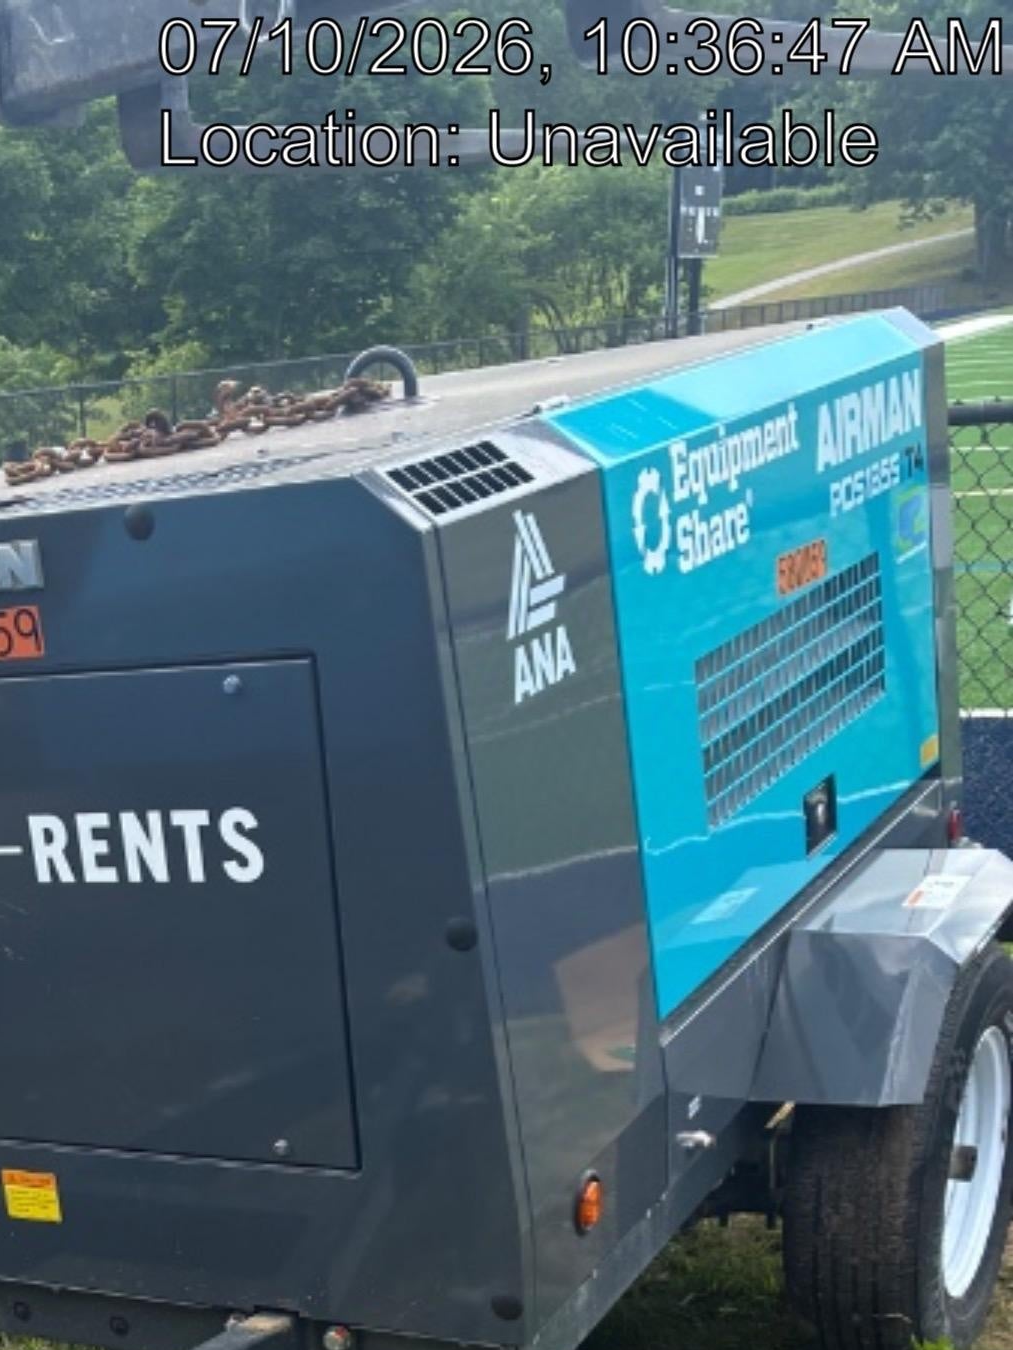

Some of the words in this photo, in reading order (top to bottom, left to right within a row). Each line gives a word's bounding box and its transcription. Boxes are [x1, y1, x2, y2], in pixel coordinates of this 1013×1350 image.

[669, 401, 800, 505] Equipment
[817, 368, 923, 474] AIRMAN
[515, 625, 577, 706] ANA
